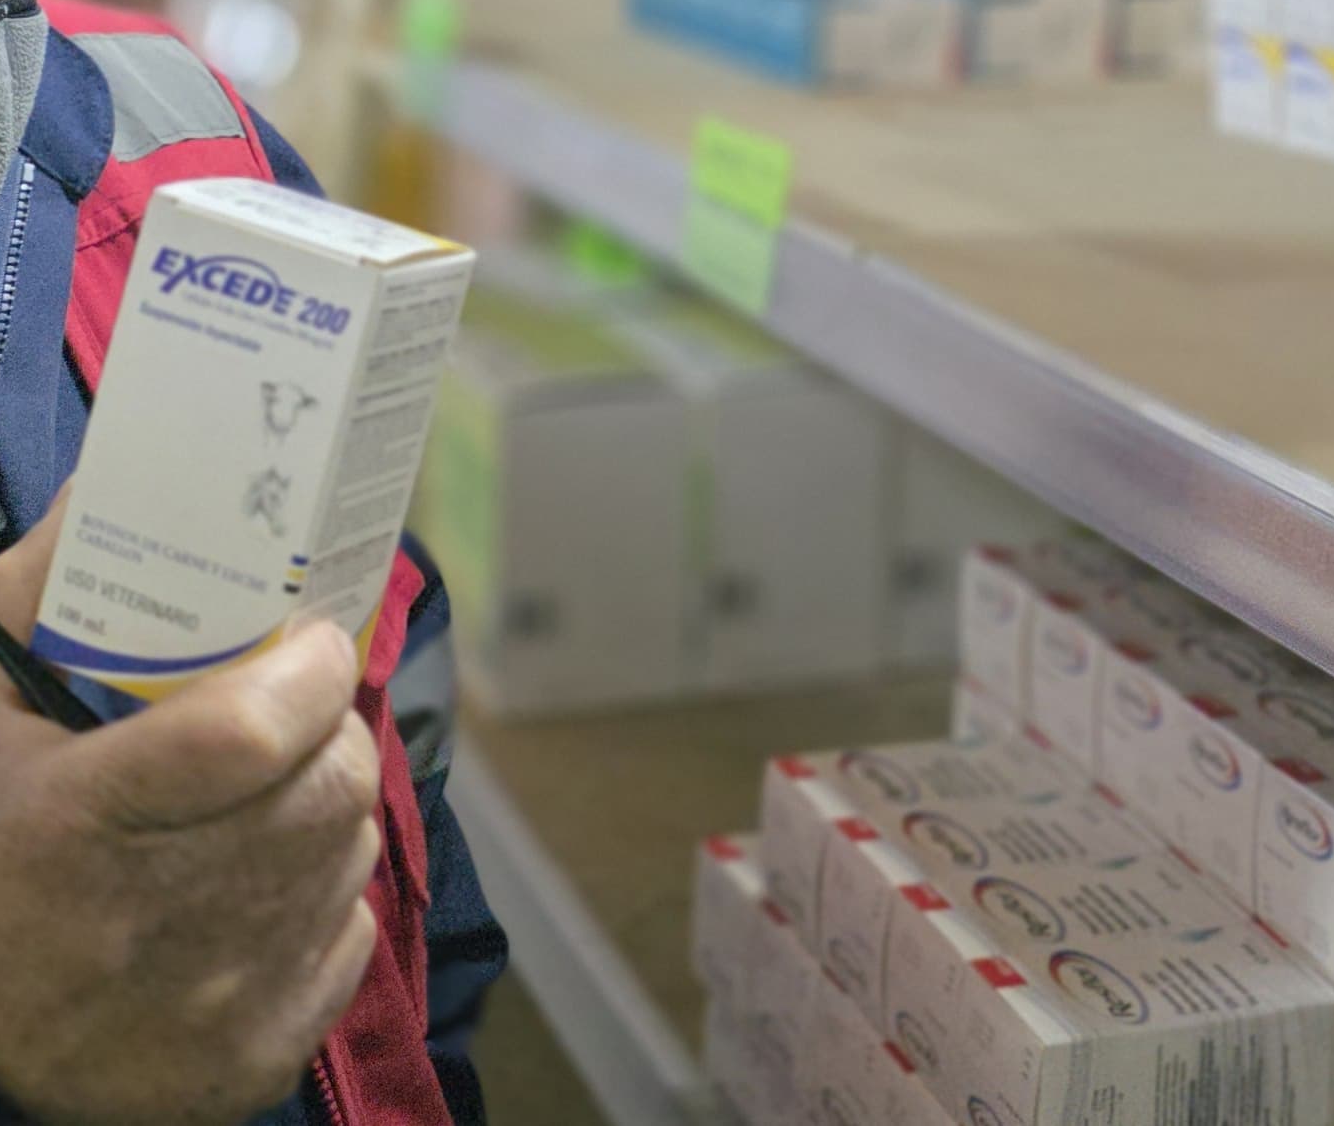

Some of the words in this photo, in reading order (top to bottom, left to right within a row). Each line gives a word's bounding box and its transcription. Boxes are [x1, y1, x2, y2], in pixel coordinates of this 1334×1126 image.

[151, 246, 297, 316] EXCEDE
[297, 296, 351, 335] 200
[64, 567, 96, 592] USO
[100, 578, 200, 631] VETERINARIO
